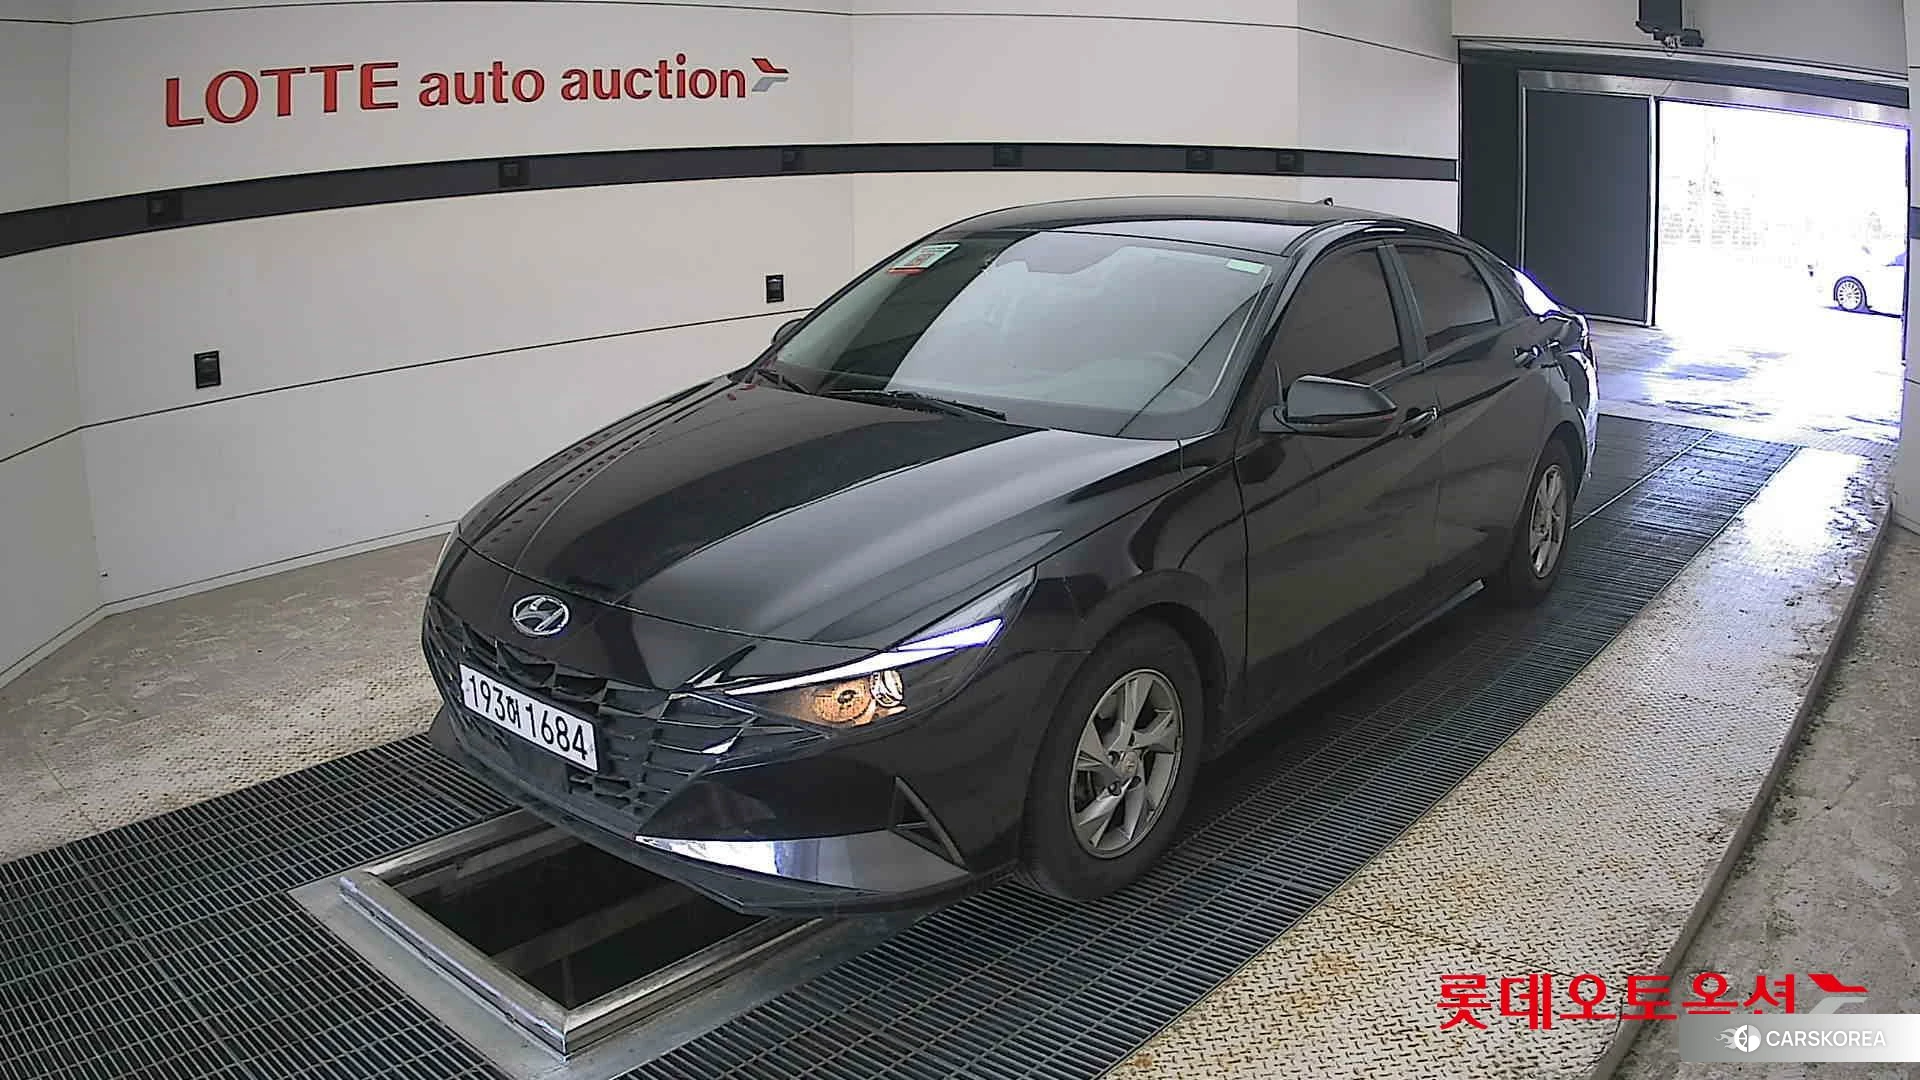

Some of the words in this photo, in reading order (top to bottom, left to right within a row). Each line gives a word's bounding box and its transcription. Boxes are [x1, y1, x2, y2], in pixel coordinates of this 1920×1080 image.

[165, 61, 400, 128] LOTTE
[418, 60, 546, 107] auto
[560, 53, 748, 101] auction
